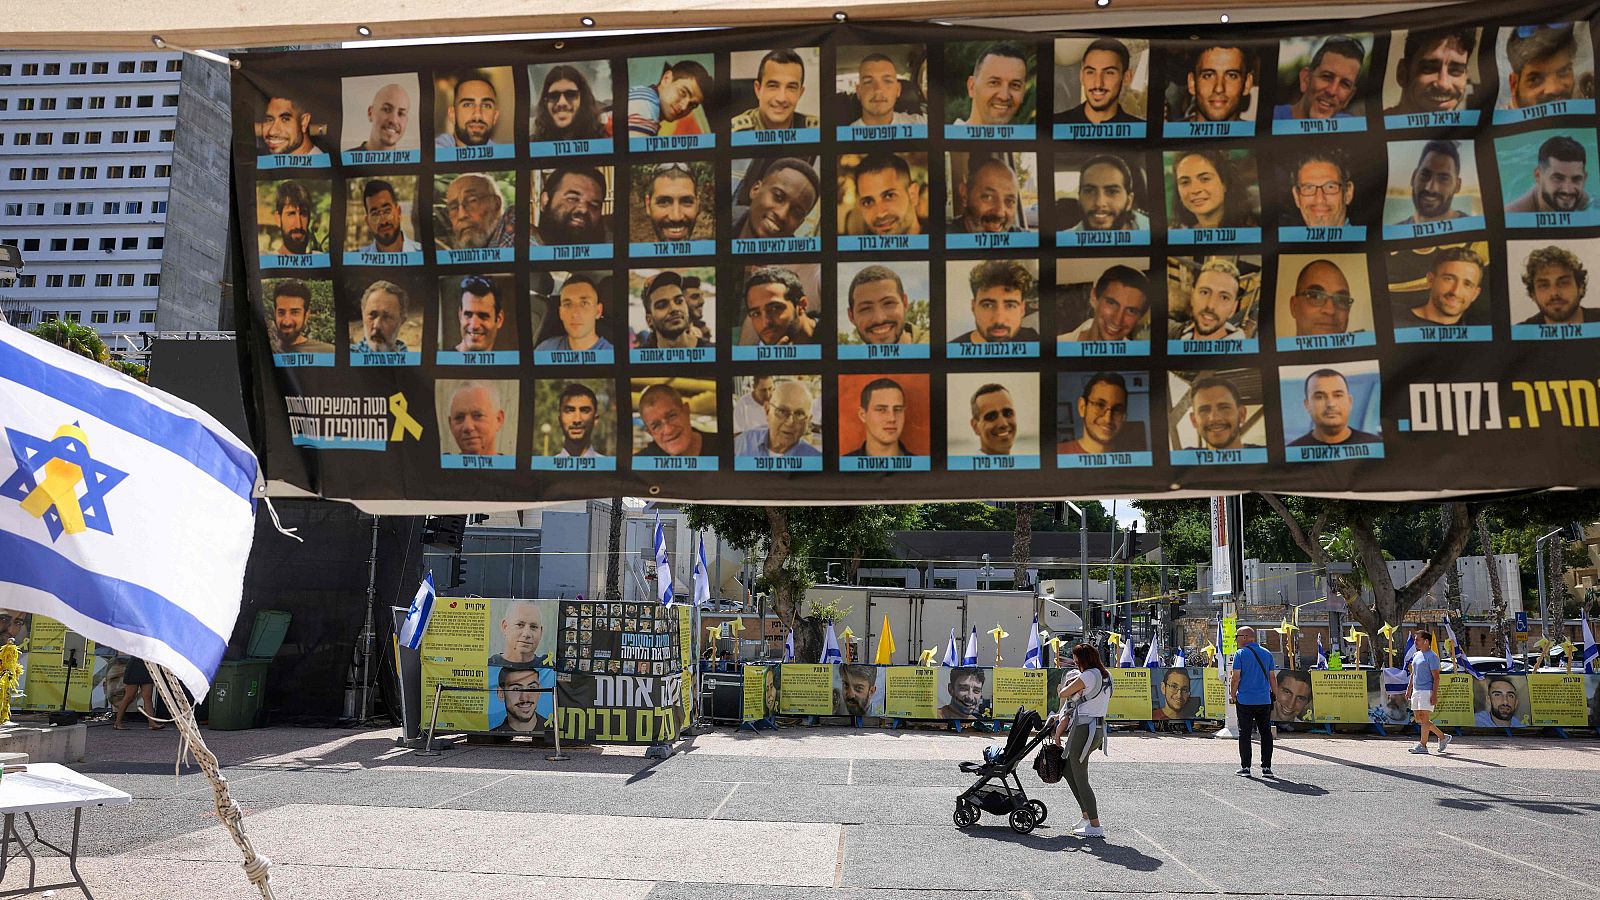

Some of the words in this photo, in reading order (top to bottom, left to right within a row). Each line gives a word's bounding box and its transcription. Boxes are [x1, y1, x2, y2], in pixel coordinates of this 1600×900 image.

[1523, 104, 1547, 119] קוניו
[1552, 101, 1566, 113] דוד
[1407, 114, 1430, 127] קוניו
[1434, 111, 1460, 125] אריאל
[1116, 124, 1130, 136] רום
[1189, 123, 1213, 135] דניאל
[1216, 123, 1230, 135] עוז
[1300, 120, 1324, 132] חיימי
[1326, 118, 1337, 131] טל
[755, 131, 776, 142] חממי
[778, 130, 796, 143] אסף
[902, 126, 912, 137] בר
[967, 127, 994, 138] שרעבי
[1000, 127, 1014, 137] יוסי
[1069, 124, 1114, 139] ברסלבסקי
[574, 141, 588, 152] סהר
[646, 137, 669, 150] הרקין
[672, 136, 698, 148] מקסים
[456, 147, 476, 161] כלפון
[478, 146, 494, 158] שגב
[553, 142, 570, 155] ברוך
[274, 156, 286, 166] דוד
[289, 155, 312, 166] אביתר
[350, 153, 364, 163] מור
[365, 152, 390, 162] אברהם
[393, 152, 410, 164] איתן
[1536, 213, 1559, 226] ברמן
[1561, 213, 1570, 224] זיו
[1413, 224, 1435, 237] ברמן
[1439, 220, 1453, 232] גלי
[1075, 233, 1112, 246] צנגאוקר
[1114, 232, 1130, 245] מתן
[1194, 230, 1213, 243] הימן
[1215, 229, 1236, 240] ענבר
[1306, 227, 1325, 240] אנגל
[1327, 228, 1342, 242] רונן
[737, 240, 756, 252] מולל
[860, 237, 876, 250] ברוך
[879, 235, 909, 248] אוריאל
[976, 235, 988, 246] לוי
[989, 234, 1009, 248] איתן
[553, 246, 569, 260] הורן
[572, 246, 589, 259] איתן
[654, 243, 670, 254] אדר
[672, 242, 691, 254] תמיר
[278, 255, 299, 266] אילוז
[302, 255, 313, 265] גיא
[361, 253, 385, 264] גואילי
[388, 254, 398, 264] רני
[401, 254, 408, 265] רן
[483, 250, 500, 260] אריה
[1420, 328, 1436, 340] אור
[1438, 327, 1468, 341] אבינתן
[1539, 325, 1558, 338] אהל
[1561, 324, 1582, 338] אלון
[1183, 341, 1212, 353] בוחבוט
[1213, 340, 1242, 354] אלקנה
[1296, 336, 1328, 349] רודאיף
[1330, 335, 1355, 347] ליאור
[757, 347, 771, 360] כהן
[775, 347, 796, 358] נמרוד
[868, 345, 877, 358] חן
[880, 346, 899, 356] איתי
[960, 343, 983, 356] דלאל
[985, 343, 1009, 356] גלבוע
[1012, 344, 1026, 355] גיא
[1081, 342, 1106, 356] גולדין
[1109, 343, 1126, 354] הדר
[298, 354, 314, 367] עידן
[386, 353, 406, 365] אליהו
[463, 353, 478, 364] אור
[480, 353, 494, 363] דרור
[551, 352, 579, 362] אנגרסט
[582, 352, 596, 364] מתן
[640, 350, 664, 361] אוחנה
[667, 350, 685, 360] חיים
[686, 350, 705, 362] יוסף
[364, 398, 387, 414] מטה
[1398, 382, 1502, 436] נקום.
[1508, 380, 1600, 428] חזיר.
[325, 418, 388, 441] החטופים
[1216, 450, 1241, 462] דניאל
[1342, 445, 1368, 456] מחמד
[462, 456, 478, 466] וייס
[480, 456, 493, 468] אילן
[577, 457, 595, 470] ביפין
[653, 458, 682, 468] גודארד
[684, 458, 696, 468] מני
[754, 457, 774, 470] קופר
[776, 457, 802, 468] עמירם
[858, 458, 889, 469] נאוטרה
[891, 457, 912, 468] עומר
[973, 457, 991, 470] מירן
[995, 457, 1015, 467] עמרי
[1079, 454, 1107, 465] נמרודי
[1112, 454, 1131, 464] תמיר
[1195, 453, 1213, 464] פרץ
[621, 646, 650, 660] הלחימה
[594, 675, 654, 708] אחת
